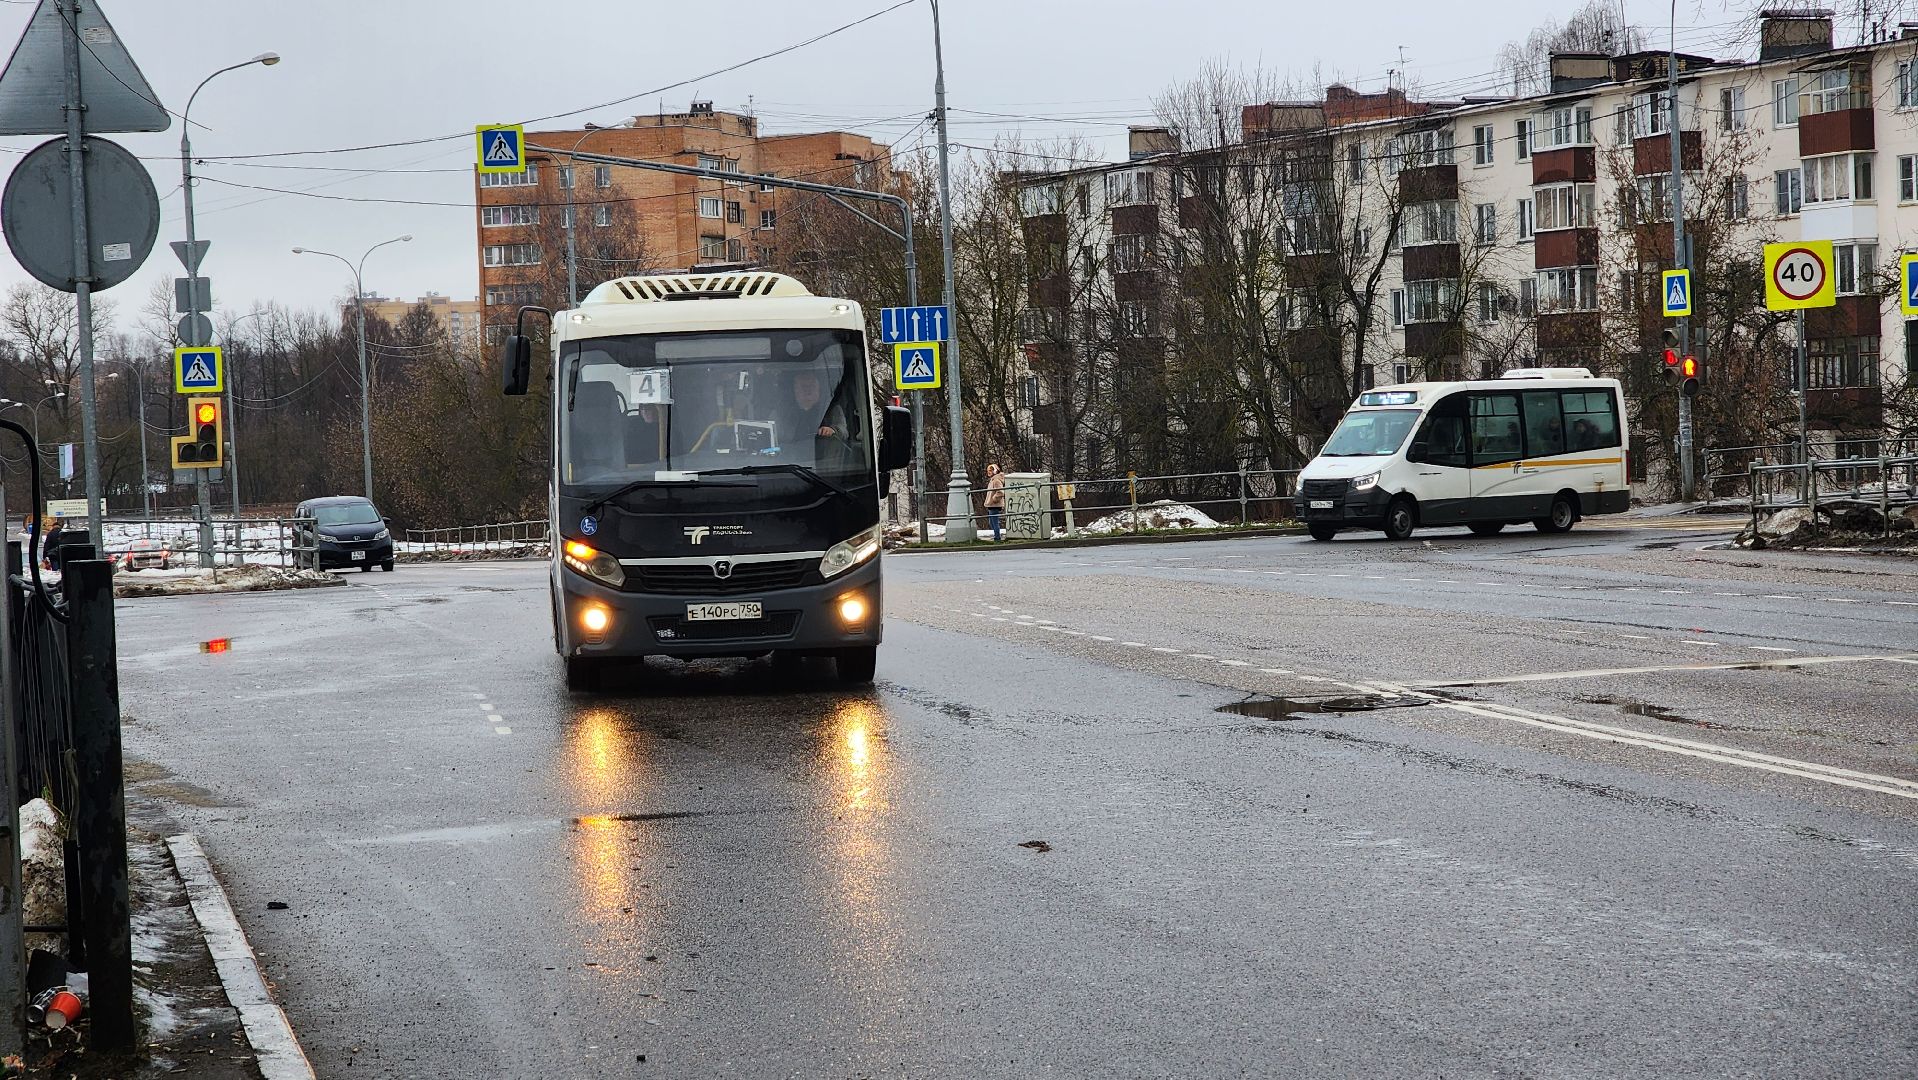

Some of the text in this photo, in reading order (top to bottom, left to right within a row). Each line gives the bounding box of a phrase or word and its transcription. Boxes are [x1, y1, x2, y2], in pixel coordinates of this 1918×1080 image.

[1782, 262, 1815, 282] 40
[639, 375, 655, 397] 4
[740, 604, 759, 613] 750
